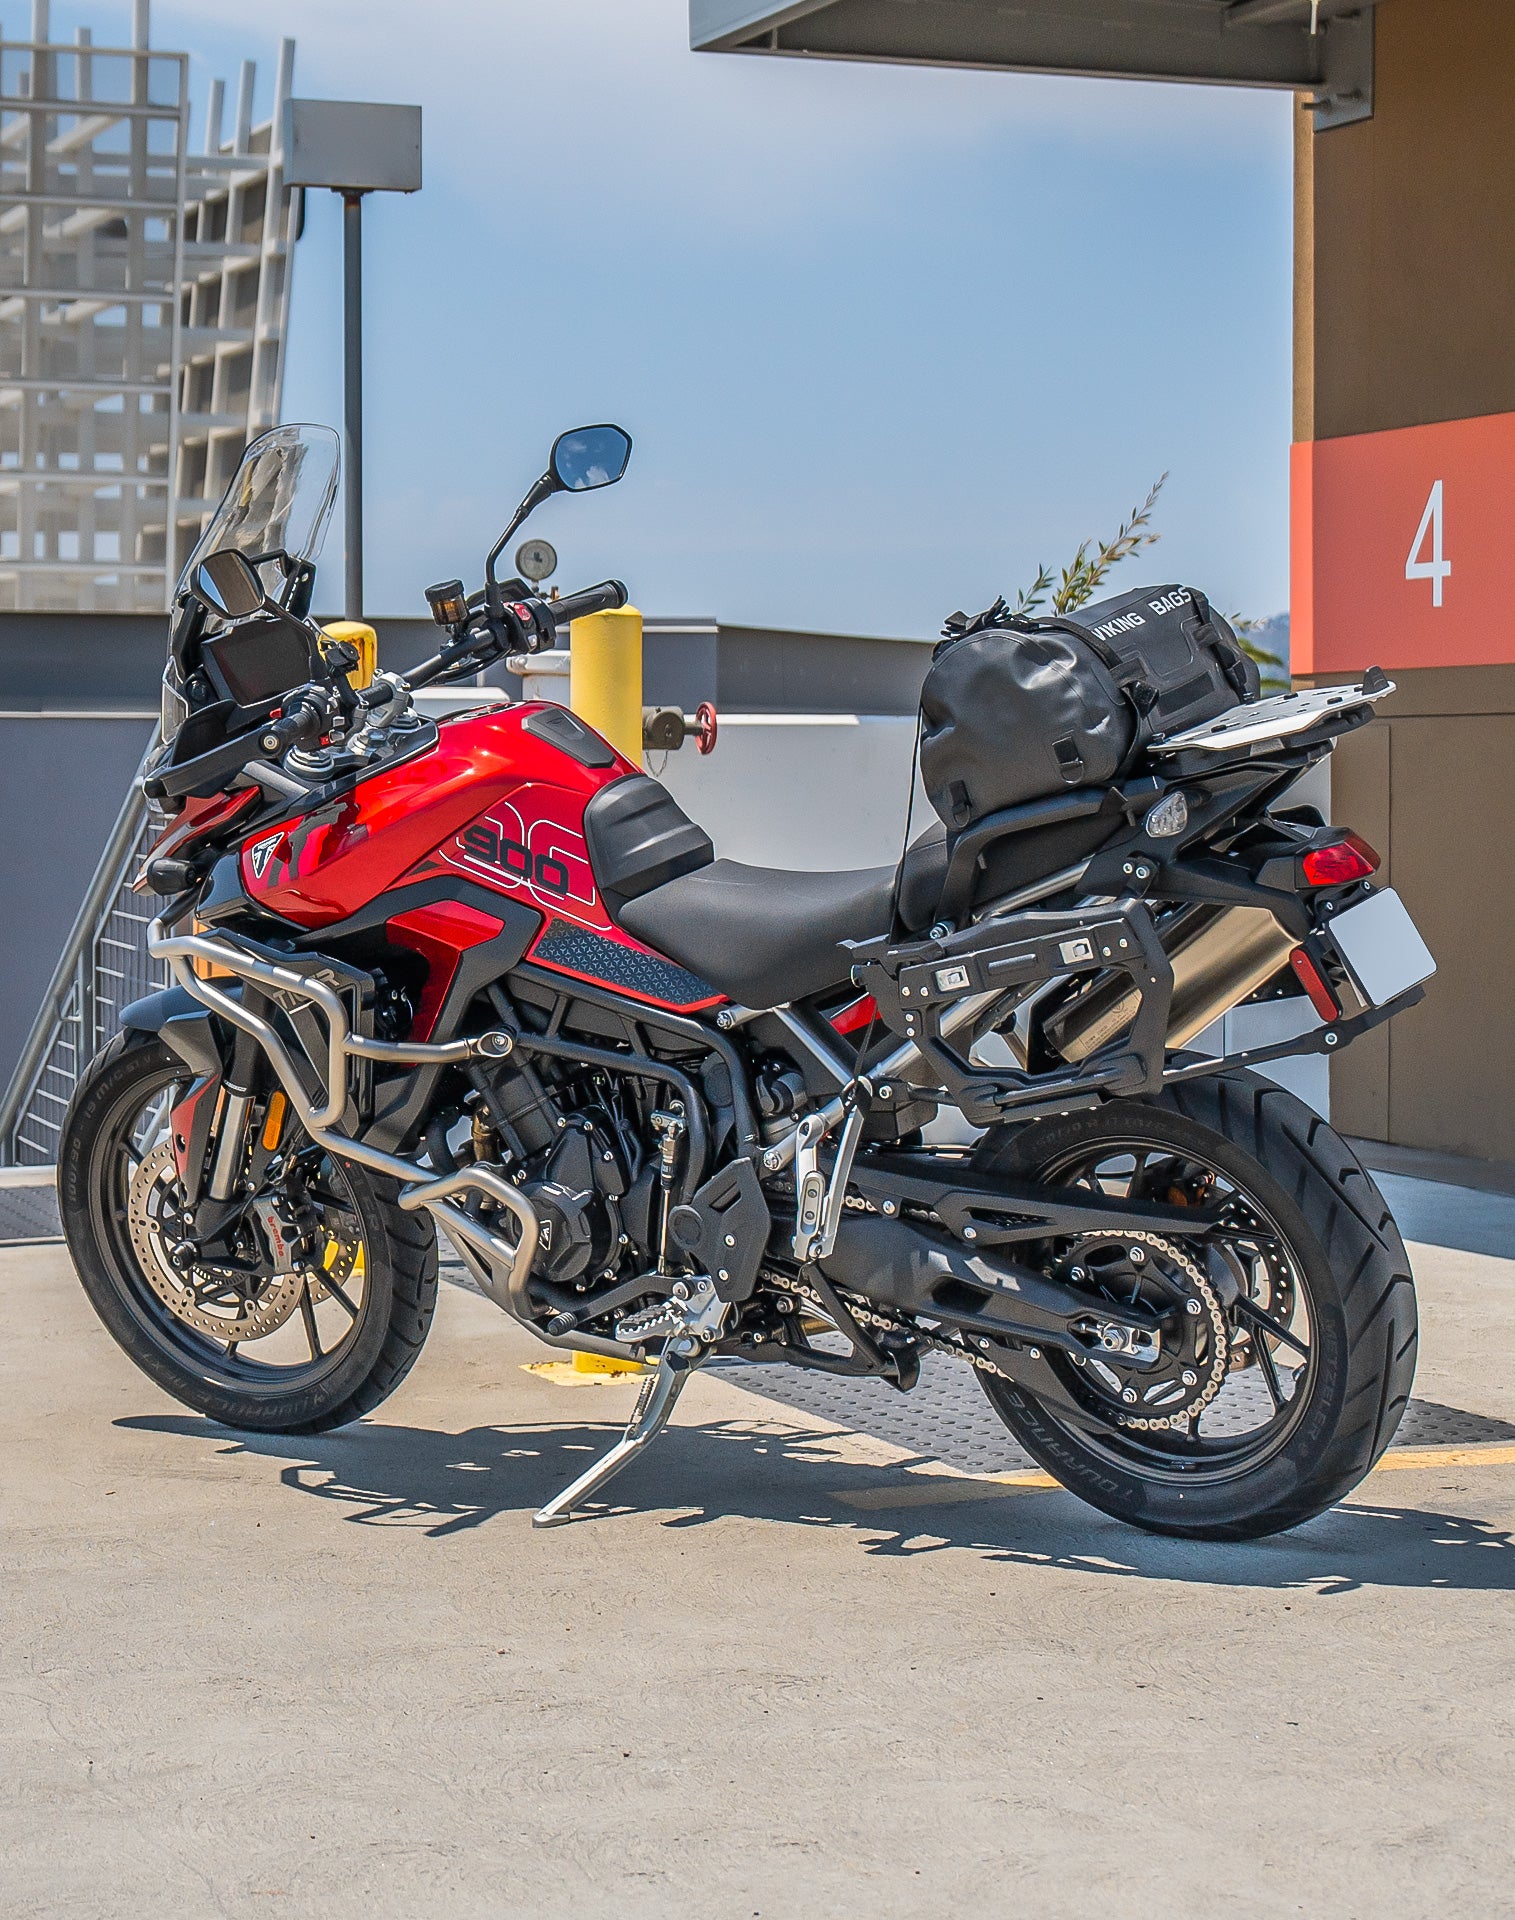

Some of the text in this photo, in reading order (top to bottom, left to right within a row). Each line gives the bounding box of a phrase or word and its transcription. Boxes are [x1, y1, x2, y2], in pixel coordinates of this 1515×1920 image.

[1405, 479, 1451, 608] 4
[1091, 588, 1192, 641] VIKING BAGS
[463, 825, 569, 895] 900
[267, 1215, 284, 1257] brembo
[1002, 1391, 1133, 1497] TOURANCE
